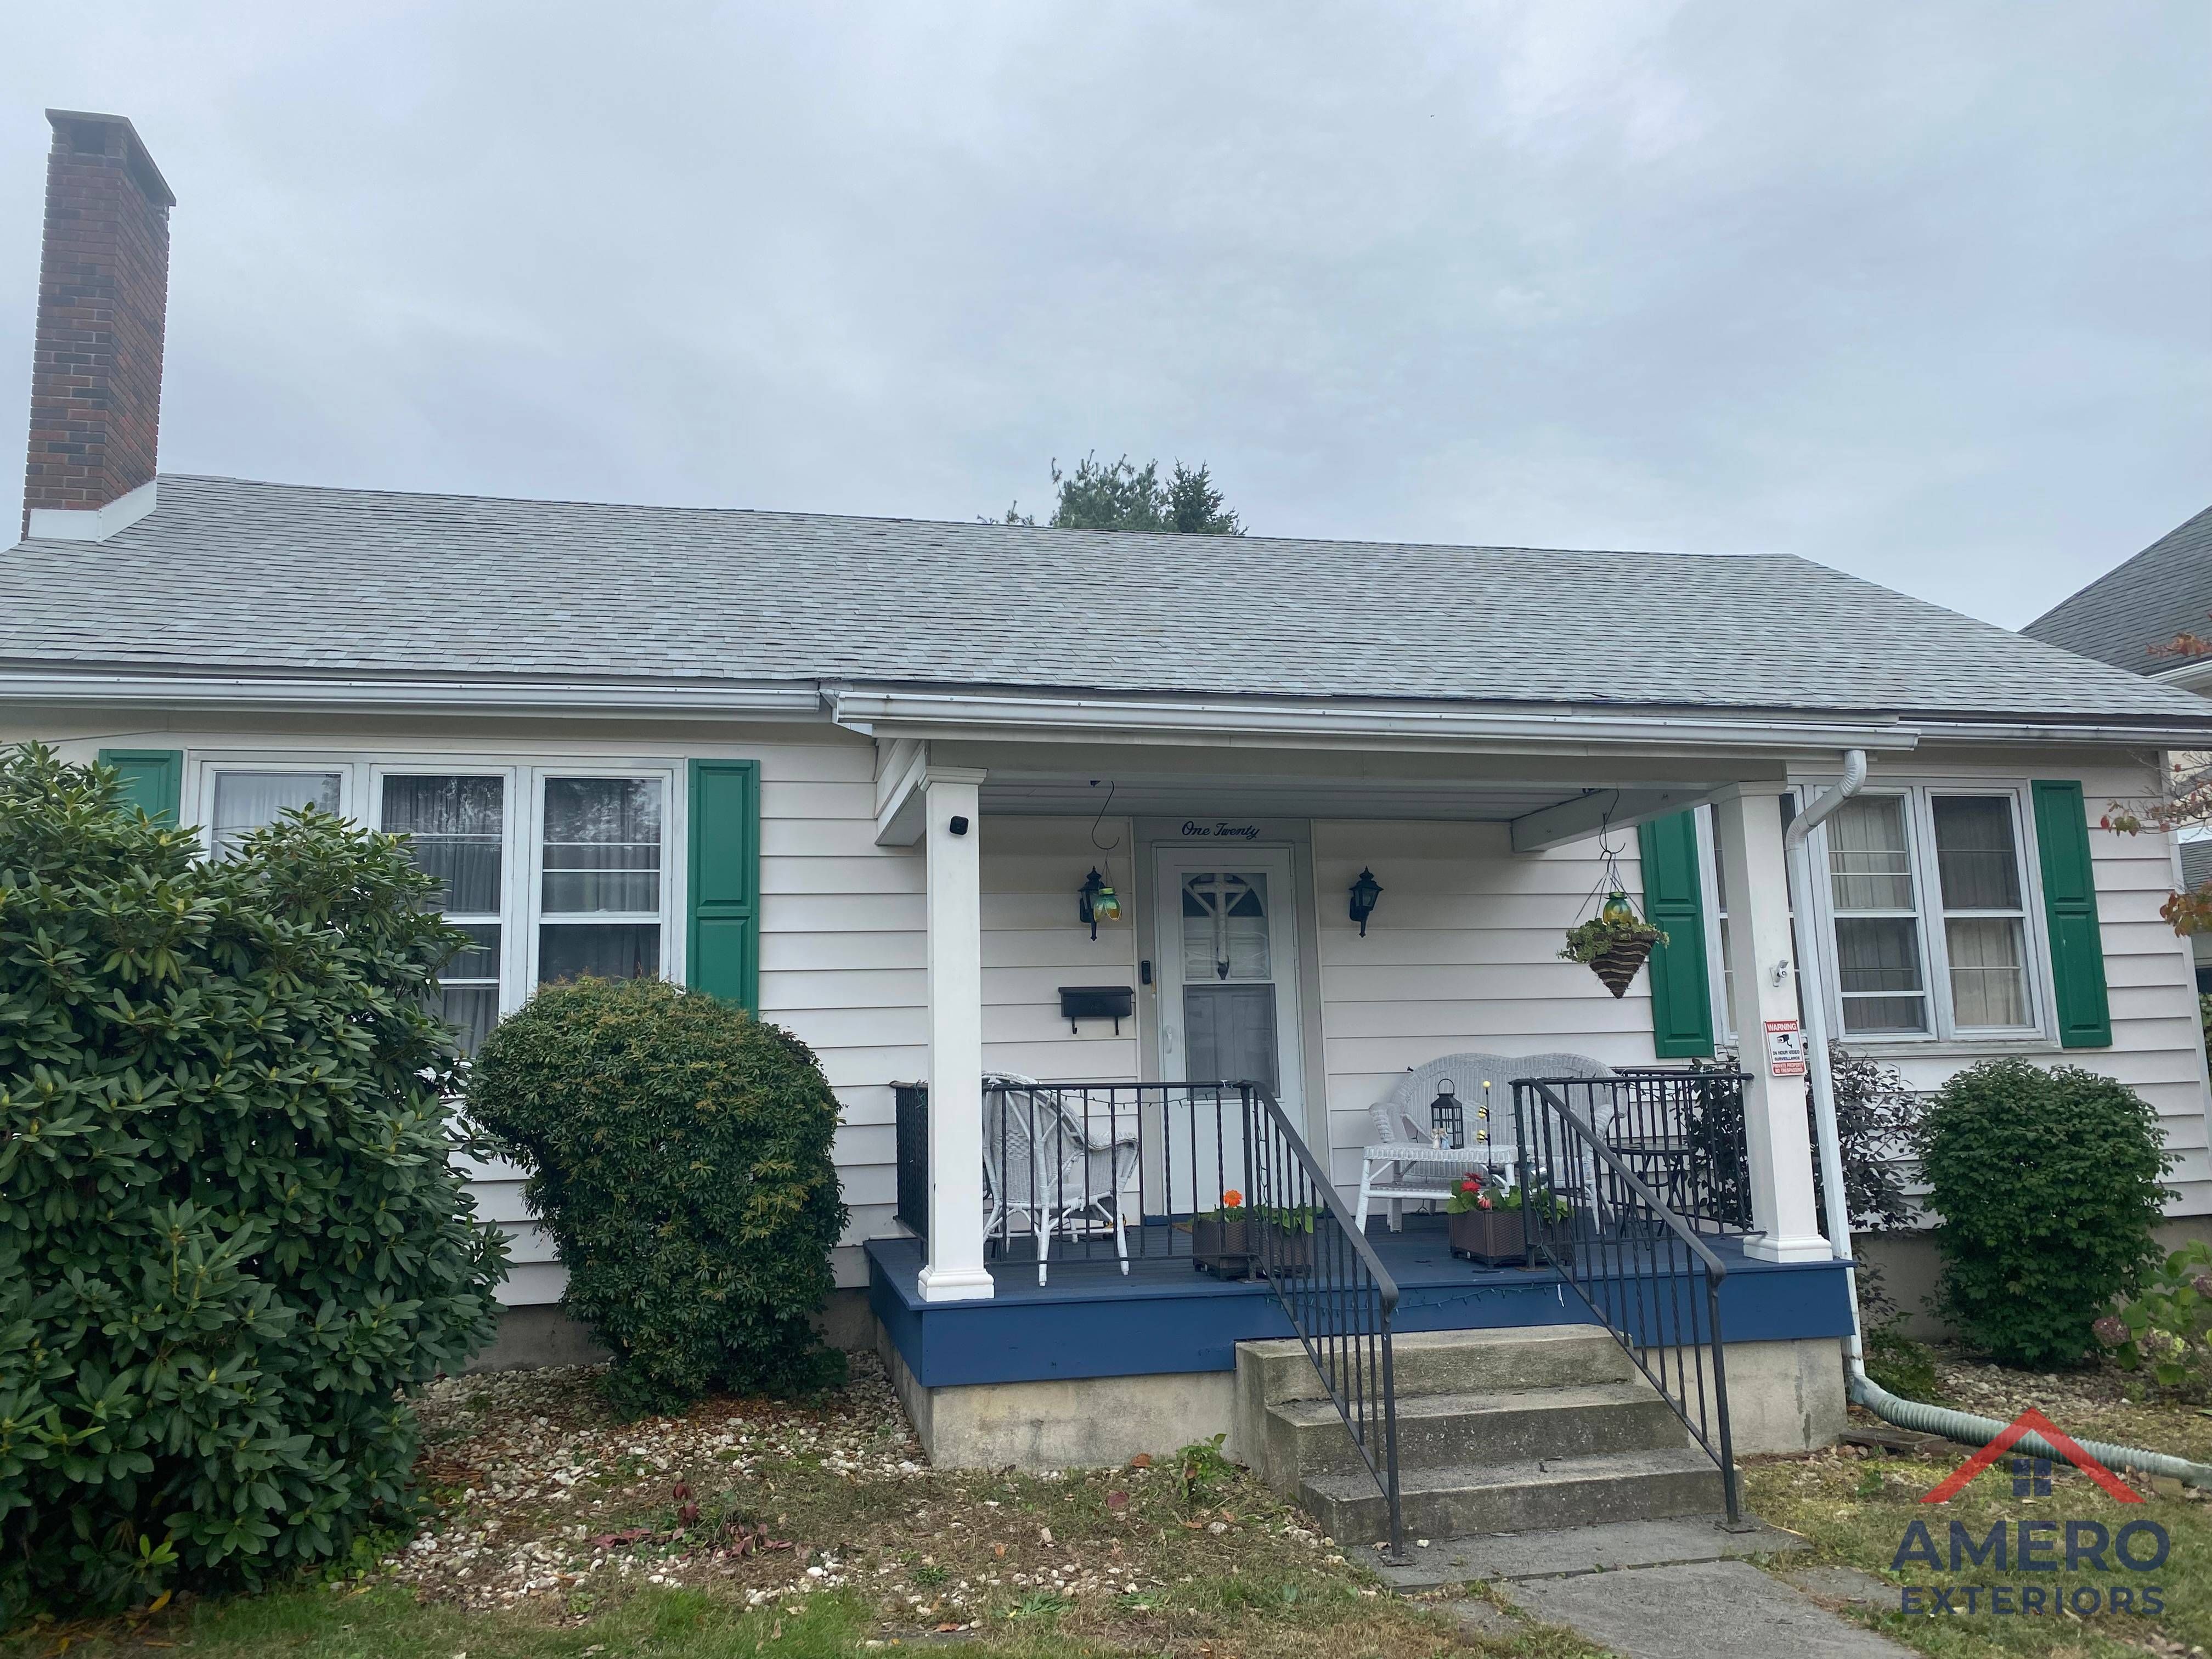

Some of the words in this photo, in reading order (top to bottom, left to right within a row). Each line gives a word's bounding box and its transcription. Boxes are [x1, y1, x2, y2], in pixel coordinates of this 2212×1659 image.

[1182, 821, 1211, 836] One
[1214, 823, 1260, 840] Twenty
[1767, 1023, 1797, 1031] WARNING
